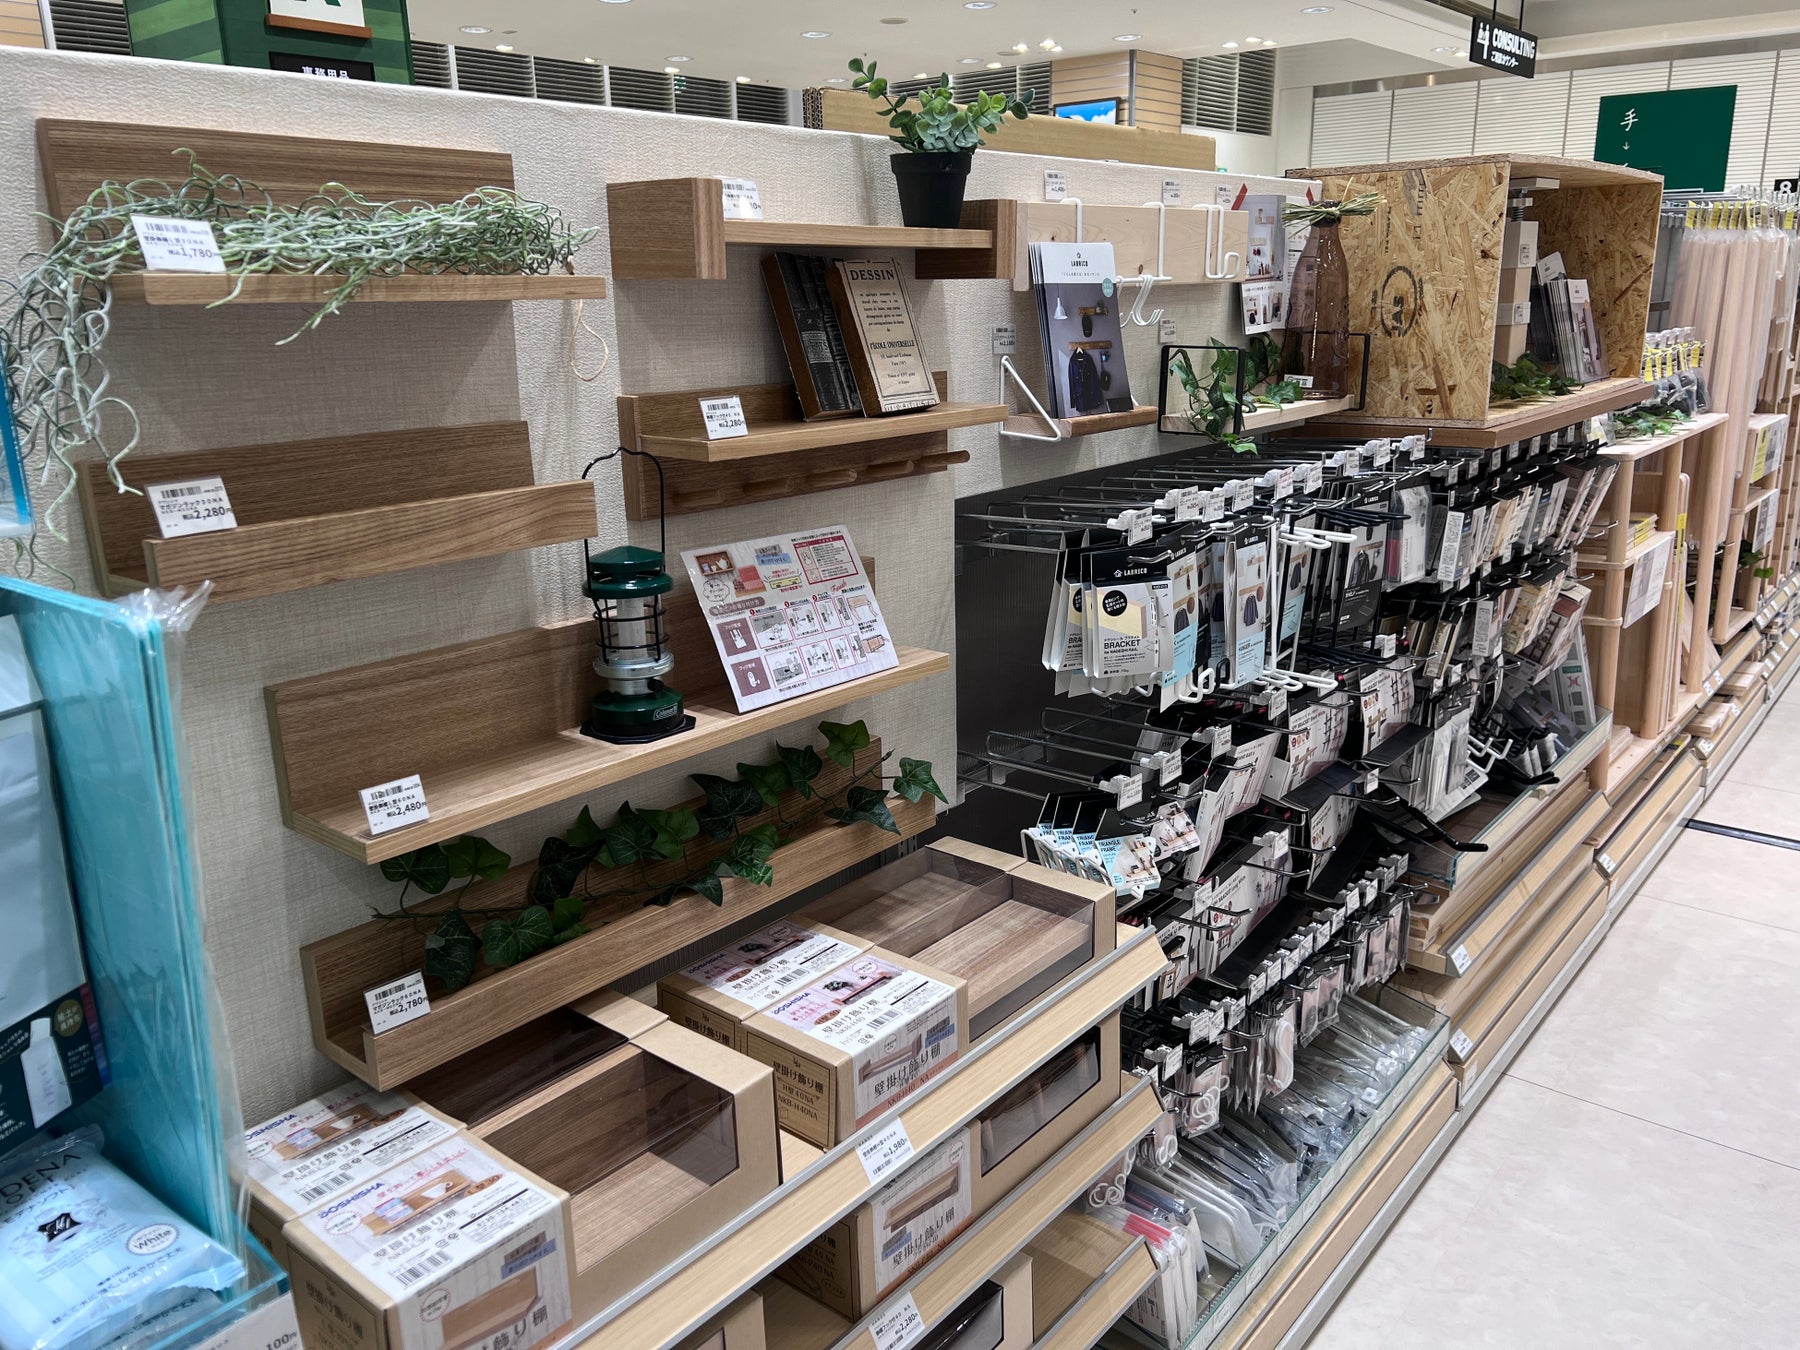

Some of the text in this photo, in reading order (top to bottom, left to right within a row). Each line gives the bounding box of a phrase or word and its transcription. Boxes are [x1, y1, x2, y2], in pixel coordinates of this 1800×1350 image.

[1492, 28, 1535, 59] CONSULTING
[1620, 108, 1639, 131] 手
[849, 269, 895, 281] DESSIN
[1124, 568, 1148, 576] LABRICO
[1104, 639, 1140, 650] BRACKET
[1099, 839, 1121, 847] TRIANGLE
[688, 953, 727, 974] DOSHISHA
[773, 992, 811, 1015] DOSHISHA
[822, 998, 879, 1034] 壁掛け飾り棚
[773, 1060, 824, 1095] 壁掛け飾り棚
[874, 1042, 941, 1097] 壁掛け飾り棚
[778, 1094, 818, 1121] NKB-H40NA
[245, 1113, 298, 1140] OSHISHA
[282, 1138, 364, 1179] 壁掛け飾り棚
[318, 1182, 385, 1219] DOSHISHA
[133, 1229, 172, 1251] White
[373, 1208, 458, 1258] 壁掛け飾り棚
[892, 1207, 955, 1267] 壁掛け飾り棚
